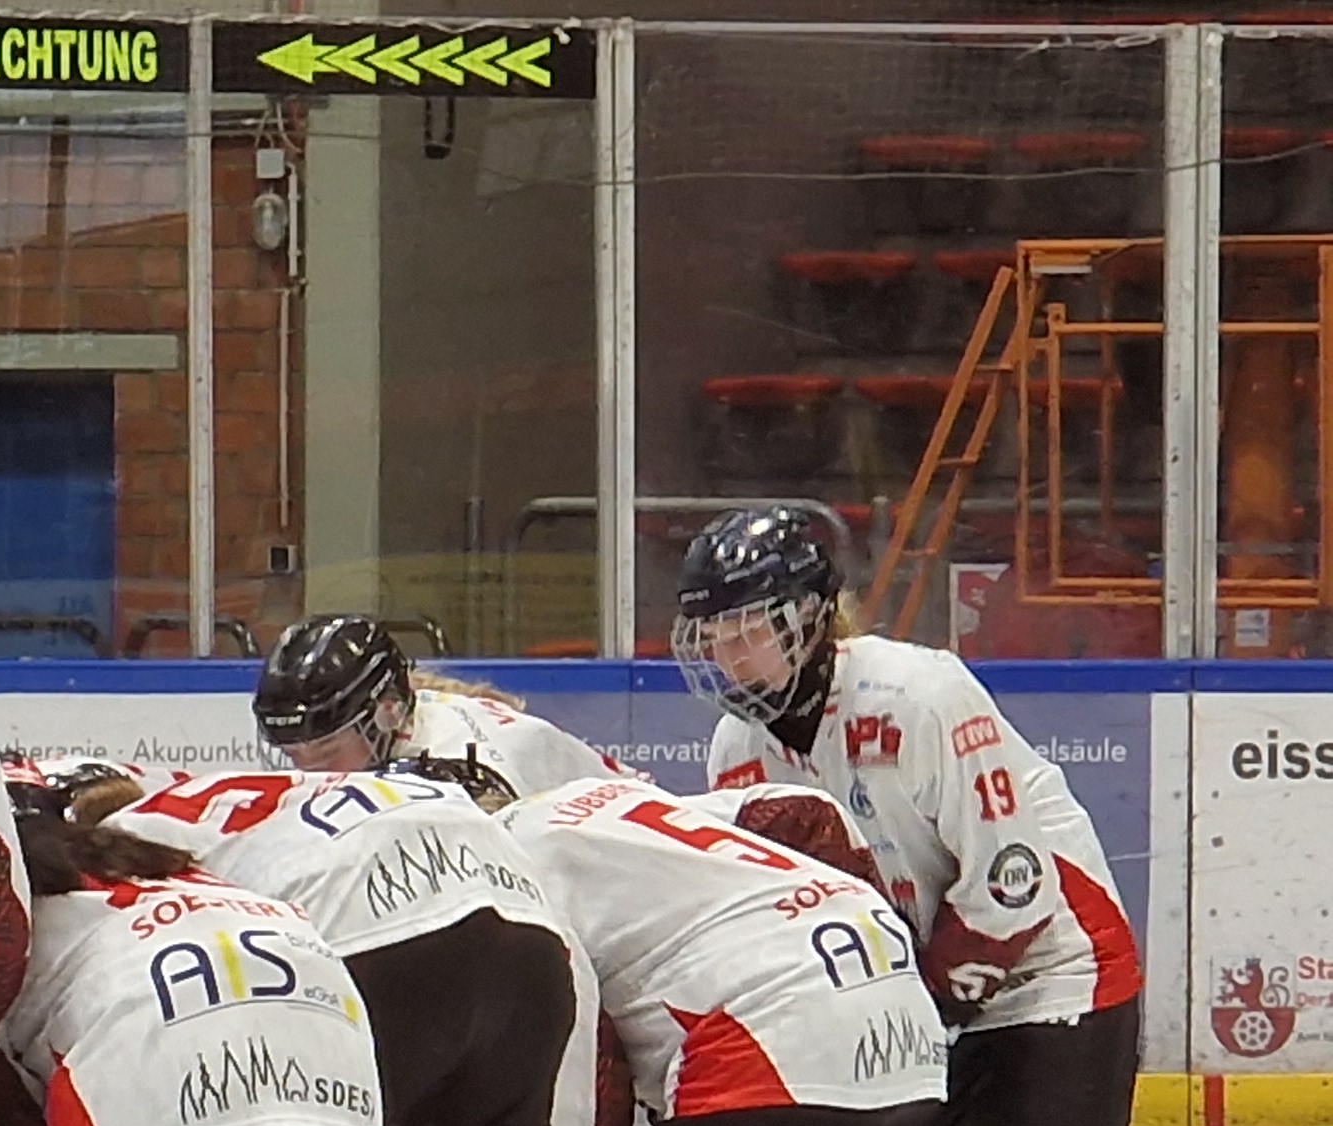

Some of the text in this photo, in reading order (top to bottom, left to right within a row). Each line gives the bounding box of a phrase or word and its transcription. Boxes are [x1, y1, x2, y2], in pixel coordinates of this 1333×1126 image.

[974, 767, 1016, 822] 19
[621, 800, 801, 871] 5
[150, 930, 297, 1023] AIS
